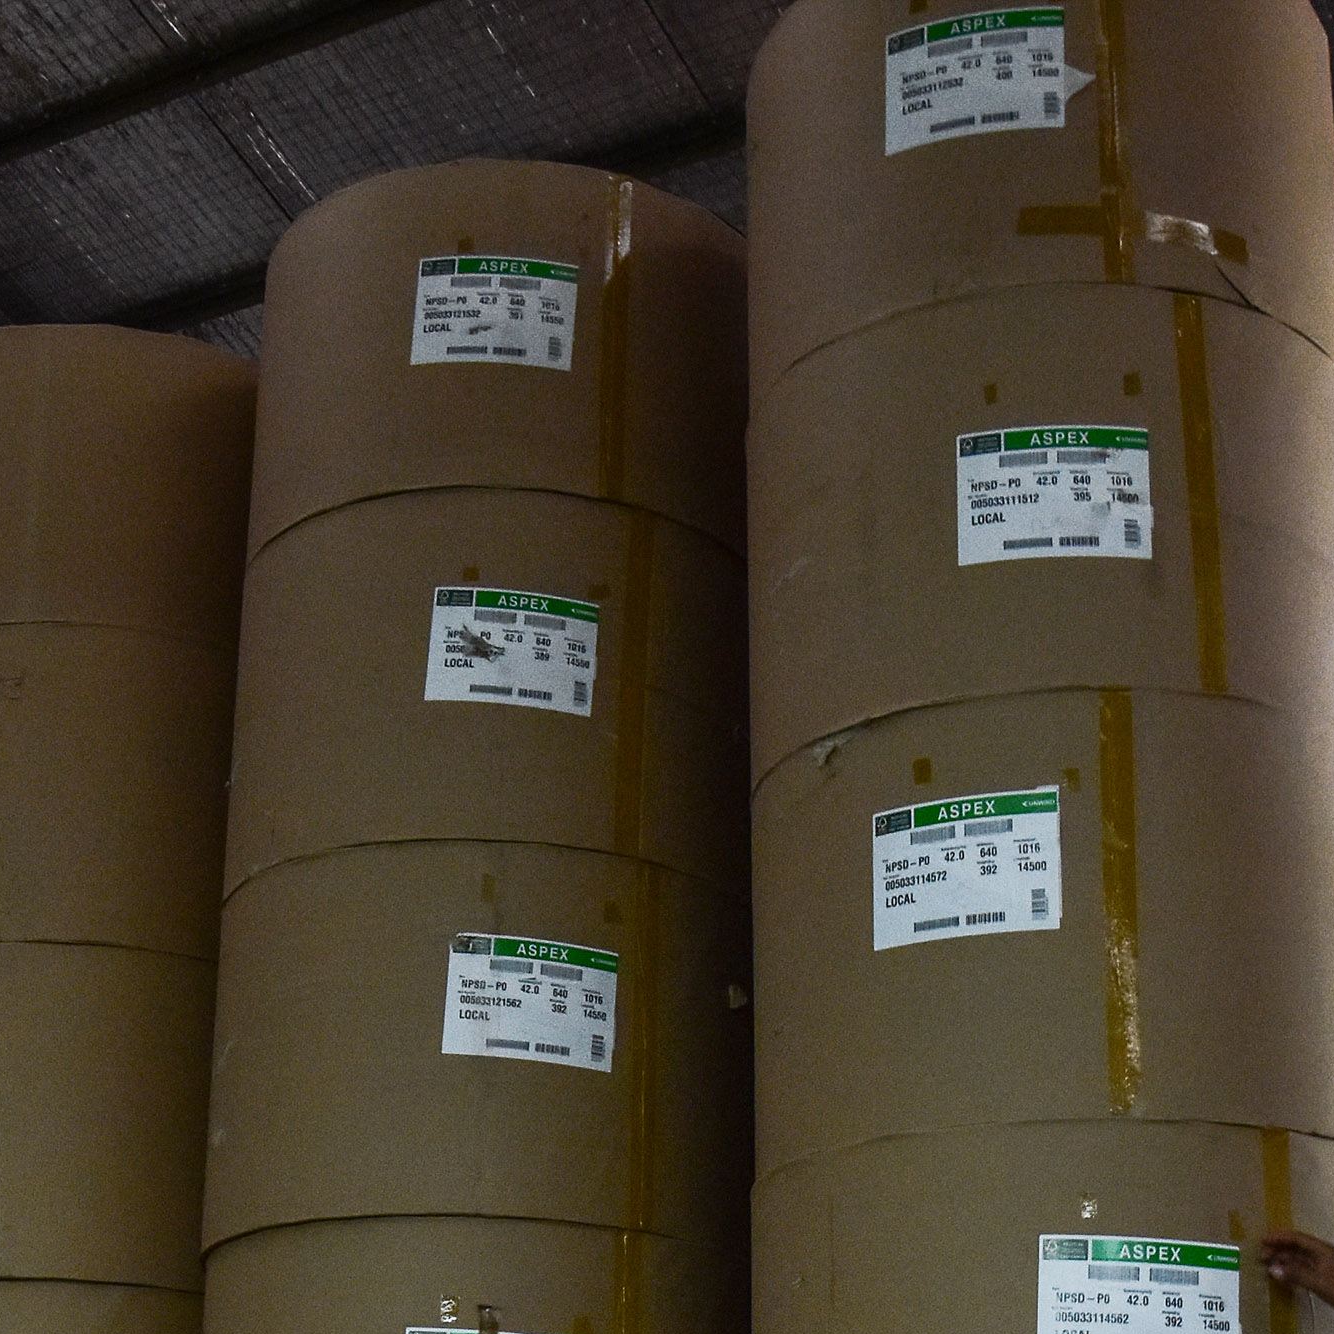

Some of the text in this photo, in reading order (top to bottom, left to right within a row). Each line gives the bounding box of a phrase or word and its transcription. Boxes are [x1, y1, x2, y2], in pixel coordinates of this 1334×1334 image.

[950, 15, 1006, 35] ASPEX
[996, 55, 1013, 65] 640
[1032, 52, 1053, 62] 1016
[902, 99, 933, 115] LOCAL
[478, 261, 529, 275] ASPEX
[479, 296, 498, 305] 42.0
[510, 297, 526, 307] 640
[541, 301, 560, 311] 1016
[423, 324, 452, 334] LOCAL
[1030, 431, 1090, 447] ASPEX
[1036, 475, 1058, 486] 42.0
[1073, 475, 1091, 485] 640
[1111, 476, 1133, 486] 1016
[970, 493, 1040, 510] 005033111512
[1072, 491, 1092, 502] 395
[971, 512, 1006, 526] LOCAL
[497, 595, 550, 611] ASPEX
[504, 633, 523, 644] 42.0
[535, 636, 552, 647] 640
[567, 642, 587, 655] 1016
[444, 658, 475, 669] LOCAL
[938, 800, 996, 821] ASPEX
[944, 849, 965, 862] 42.0
[979, 846, 998, 858] 640
[1017, 842, 1041, 855] 1016
[885, 860, 1048, 892] 005033114572 392 14500
[885, 892, 917, 909] LOCAL
[517, 943, 570, 961] ASPEX
[521, 984, 540, 996] 42.0
[552, 988, 569, 999] 640
[585, 993, 604, 1006] 1016
[459, 994, 607, 1022] 005033121562 392 14550
[459, 1009, 491, 1021] LOCAL
[1119, 1244, 1181, 1262] ASPEX
[1126, 1295, 1149, 1307] 42.0
[1164, 1296, 1183, 1309] 640
[1203, 1300, 1225, 1313] 1016
[1055, 1311, 1129, 1325] 005033114562
[1164, 1315, 1183, 1328] 392
[1202, 1319, 1230, 1332] 14500
